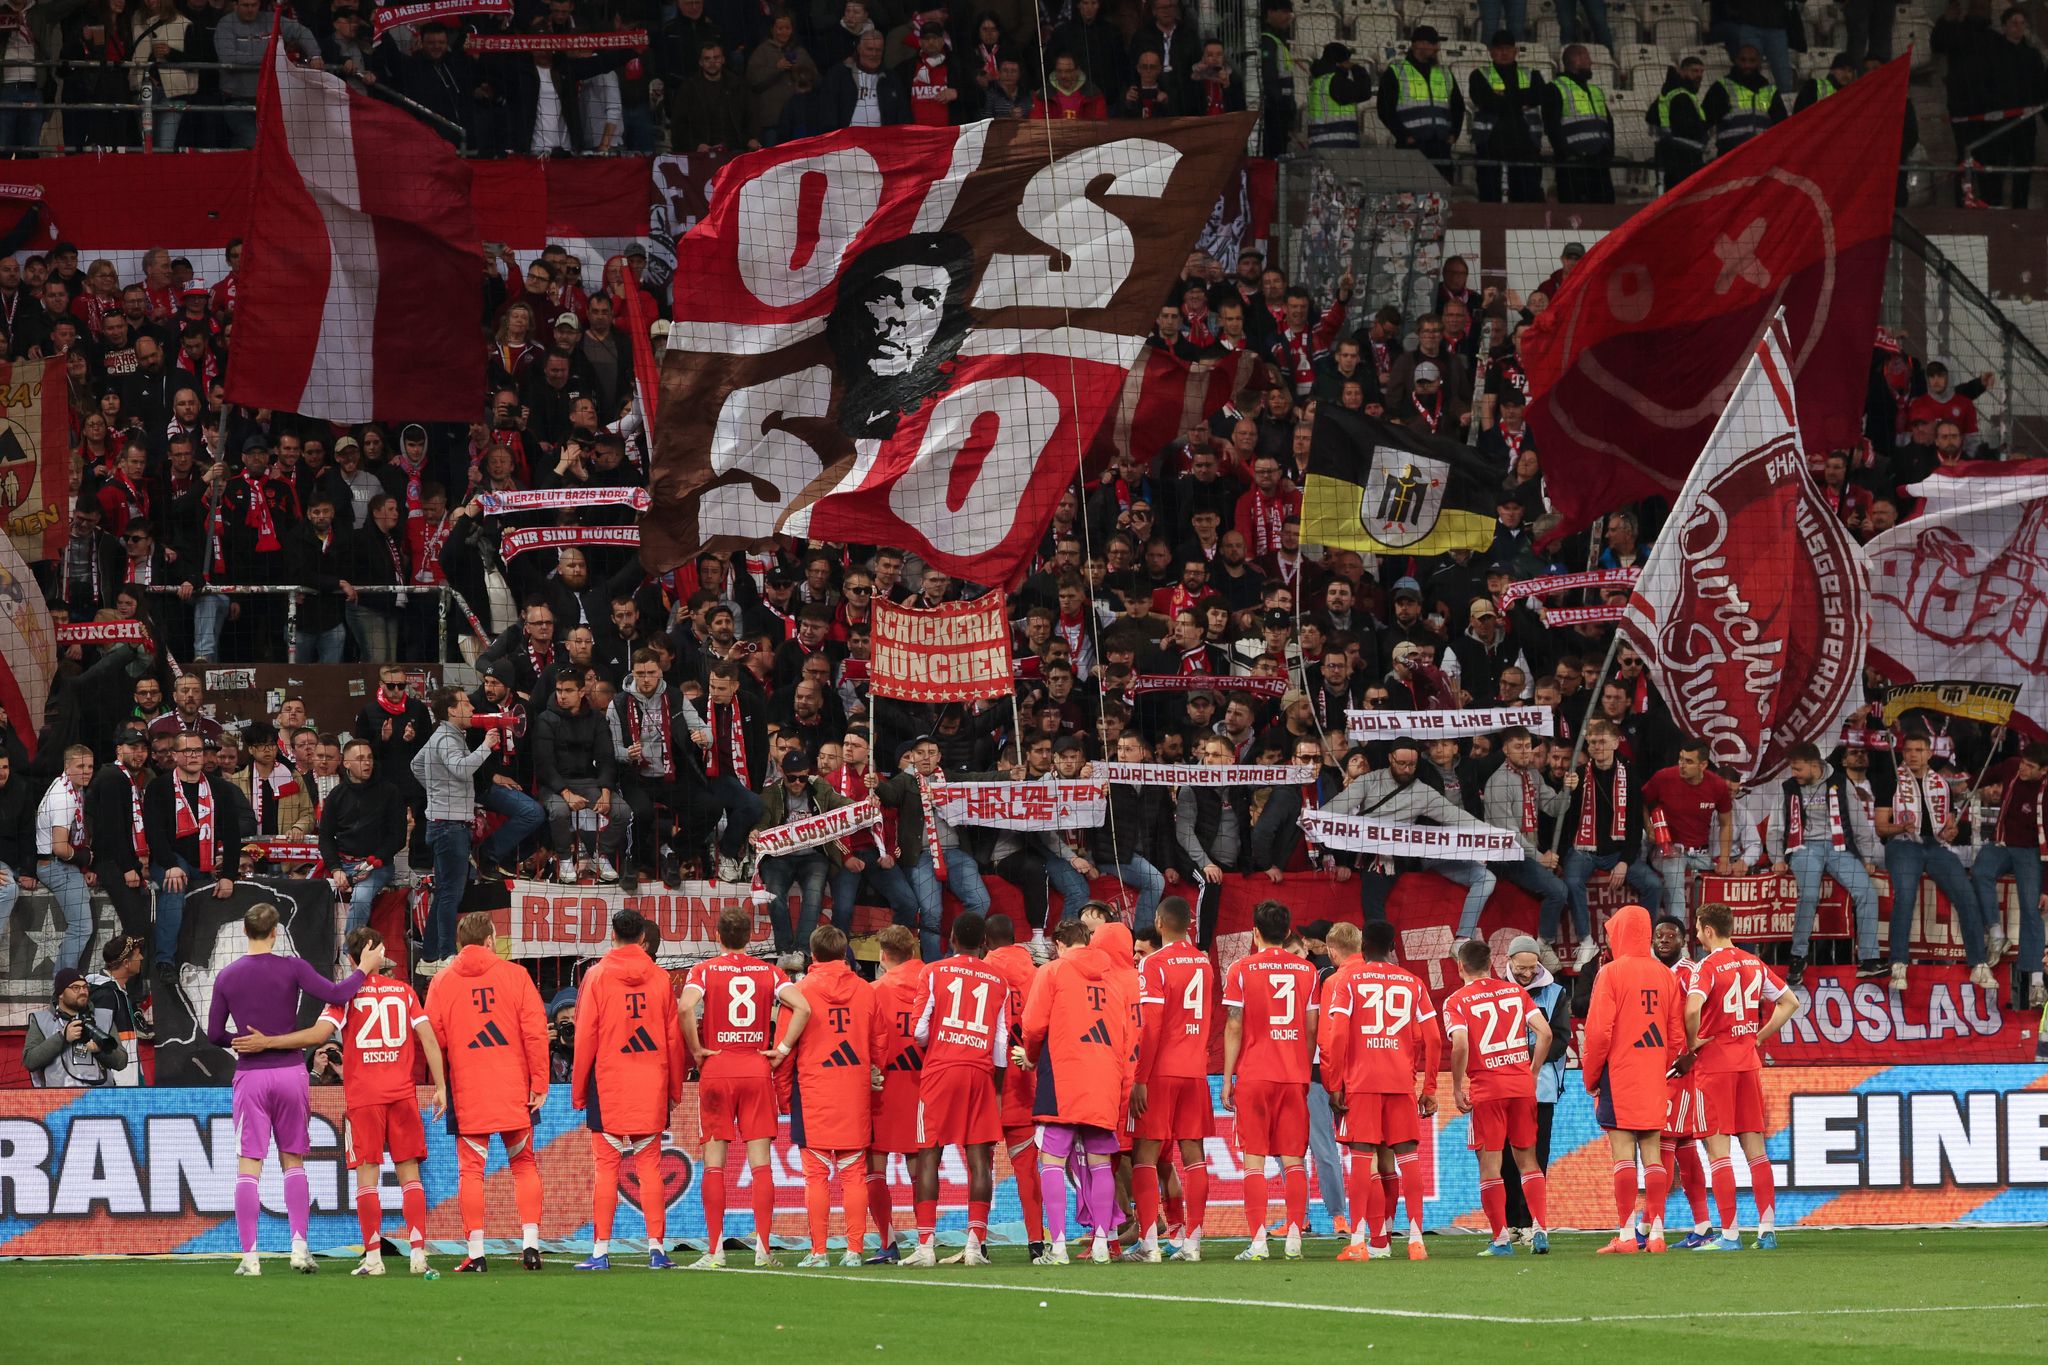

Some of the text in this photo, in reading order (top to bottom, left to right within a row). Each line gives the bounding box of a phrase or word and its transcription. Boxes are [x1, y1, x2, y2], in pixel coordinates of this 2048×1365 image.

[378, 12, 392, 23] 20
[506, 489, 628, 504] HERZBLUT BAZIS NORD
[511, 531, 539, 546] WIR
[543, 529, 577, 541] SIND
[876, 605, 1004, 647] SCHICKERIA
[874, 642, 1009, 684] MÜNCHEN
[1351, 716, 1402, 731] HOLD
[1227, 769, 1288, 781] RAMBO
[930, 785, 1006, 807] SPUR
[967, 801, 1053, 821] NIKLAS
[795, 810, 851, 843] CURVA
[1301, 816, 1360, 838] STARK
[1457, 833, 1514, 849] MAGA
[1723, 881, 1758, 902] LOVE
[1761, 879, 1777, 899] FC
[521, 895, 607, 943] RED
[1733, 913, 1767, 935] HATE
[718, 964, 742, 973] BAYERN
[950, 966, 974, 977] BAYERN
[1167, 958, 1175, 966] FC
[1176, 956, 1194, 965] BAYERN
[1249, 963, 1257, 971] FC
[1258, 962, 1282, 971] BAYERN
[1716, 965, 1725, 973] FC
[1724, 960, 1742, 971] BAYERN
[1353, 973, 1361, 981] FC
[1362, 972, 1386, 981] BAYERN
[728, 975, 756, 1027] 8
[1183, 968, 1203, 1019] 4
[1269, 973, 1296, 1025] 3
[1462, 996, 1471, 1004] FC
[1471, 991, 1494, 1001] BAYERN
[1723, 969, 1762, 1021] 44
[942, 976, 990, 1035] 11
[1357, 983, 1413, 1036] 39
[1779, 976, 2003, 1044] RÖSLAU
[354, 996, 407, 1049] 20
[1470, 996, 1529, 1056] 22
[717, 1031, 764, 1043] GORETZKA
[937, 1030, 988, 1050] N.JACKSON
[1484, 1050, 1531, 1069] GUERREIRO
